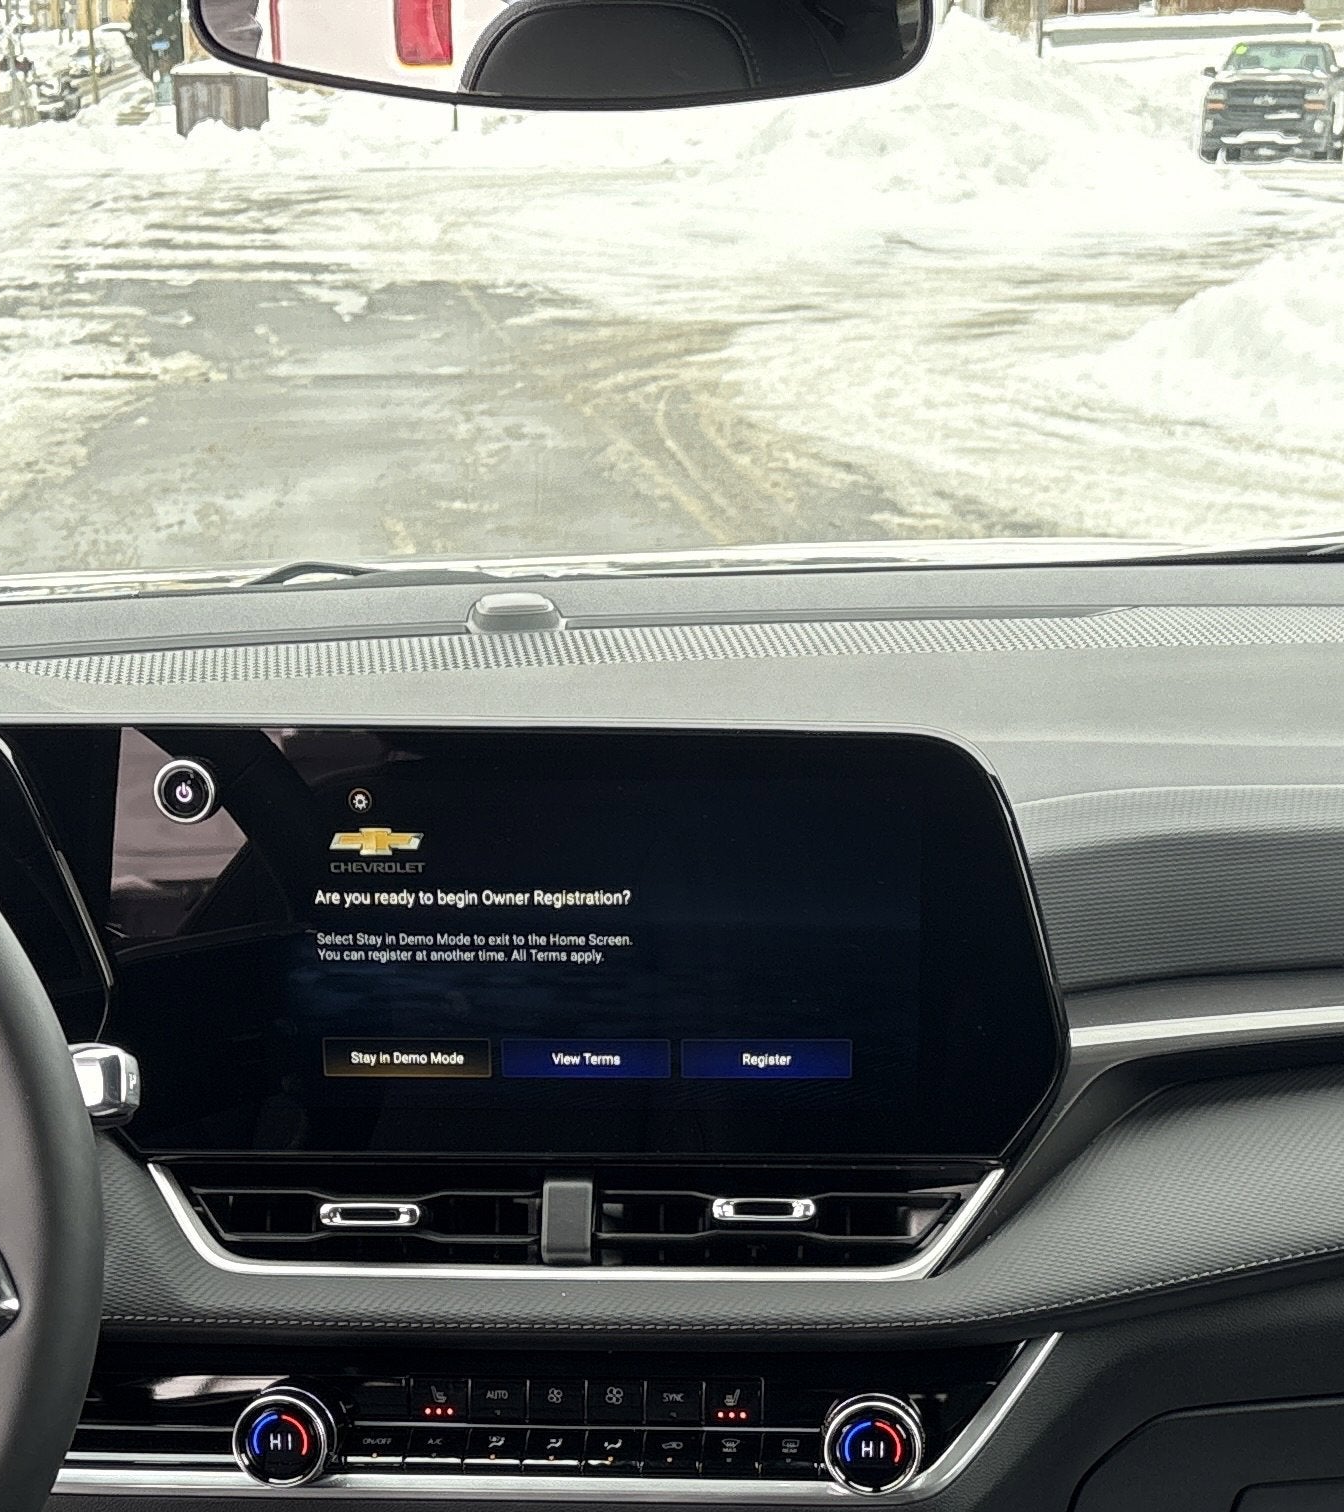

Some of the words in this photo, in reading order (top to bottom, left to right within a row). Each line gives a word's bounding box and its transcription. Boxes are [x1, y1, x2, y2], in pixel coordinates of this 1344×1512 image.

[330, 862, 425, 873] CHEVROLET
[314, 890, 340, 905] Are
[344, 892, 370, 908] you
[374, 889, 415, 908] ready
[418, 890, 433, 905] to
[437, 889, 477, 909] begin
[481, 889, 530, 906] Owner
[533, 889, 631, 909] Registration?
[317, 932, 354, 946] Select
[356, 932, 382, 948] Stay
[385, 932, 396, 945] in
[399, 932, 433, 945] Demo
[436, 932, 471, 945] Mode
[473, 933, 485, 946] to
[488, 932, 510, 946] exit
[512, 933, 525, 946] to
[528, 932, 547, 946] the
[549, 932, 586, 946] Home
[588, 932, 633, 946] Screen.
[317, 948, 341, 961] You
[343, 950, 366, 961] can
[368, 948, 412, 964] register
[415, 949, 428, 961] at
[430, 948, 475, 961] another
[478, 948, 507, 961] time.
[511, 948, 527, 961] All
[529, 949, 568, 962] Terms
[570, 948, 605, 965] apply.
[350, 1051, 377, 1066] Stay
[379, 1051, 391, 1064] in
[393, 1051, 428, 1065] Demo
[430, 1051, 465, 1065] Mode
[551, 1052, 580, 1066] View
[582, 1052, 621, 1066] Terms
[741, 1052, 792, 1068] Register
[486, 1390, 509, 1399] AUTO
[662, 1393, 685, 1402] SYNC
[270, 1433, 292, 1450] HI
[362, 1437, 392, 1445] ON/OFF
[861, 1440, 884, 1458] HI
